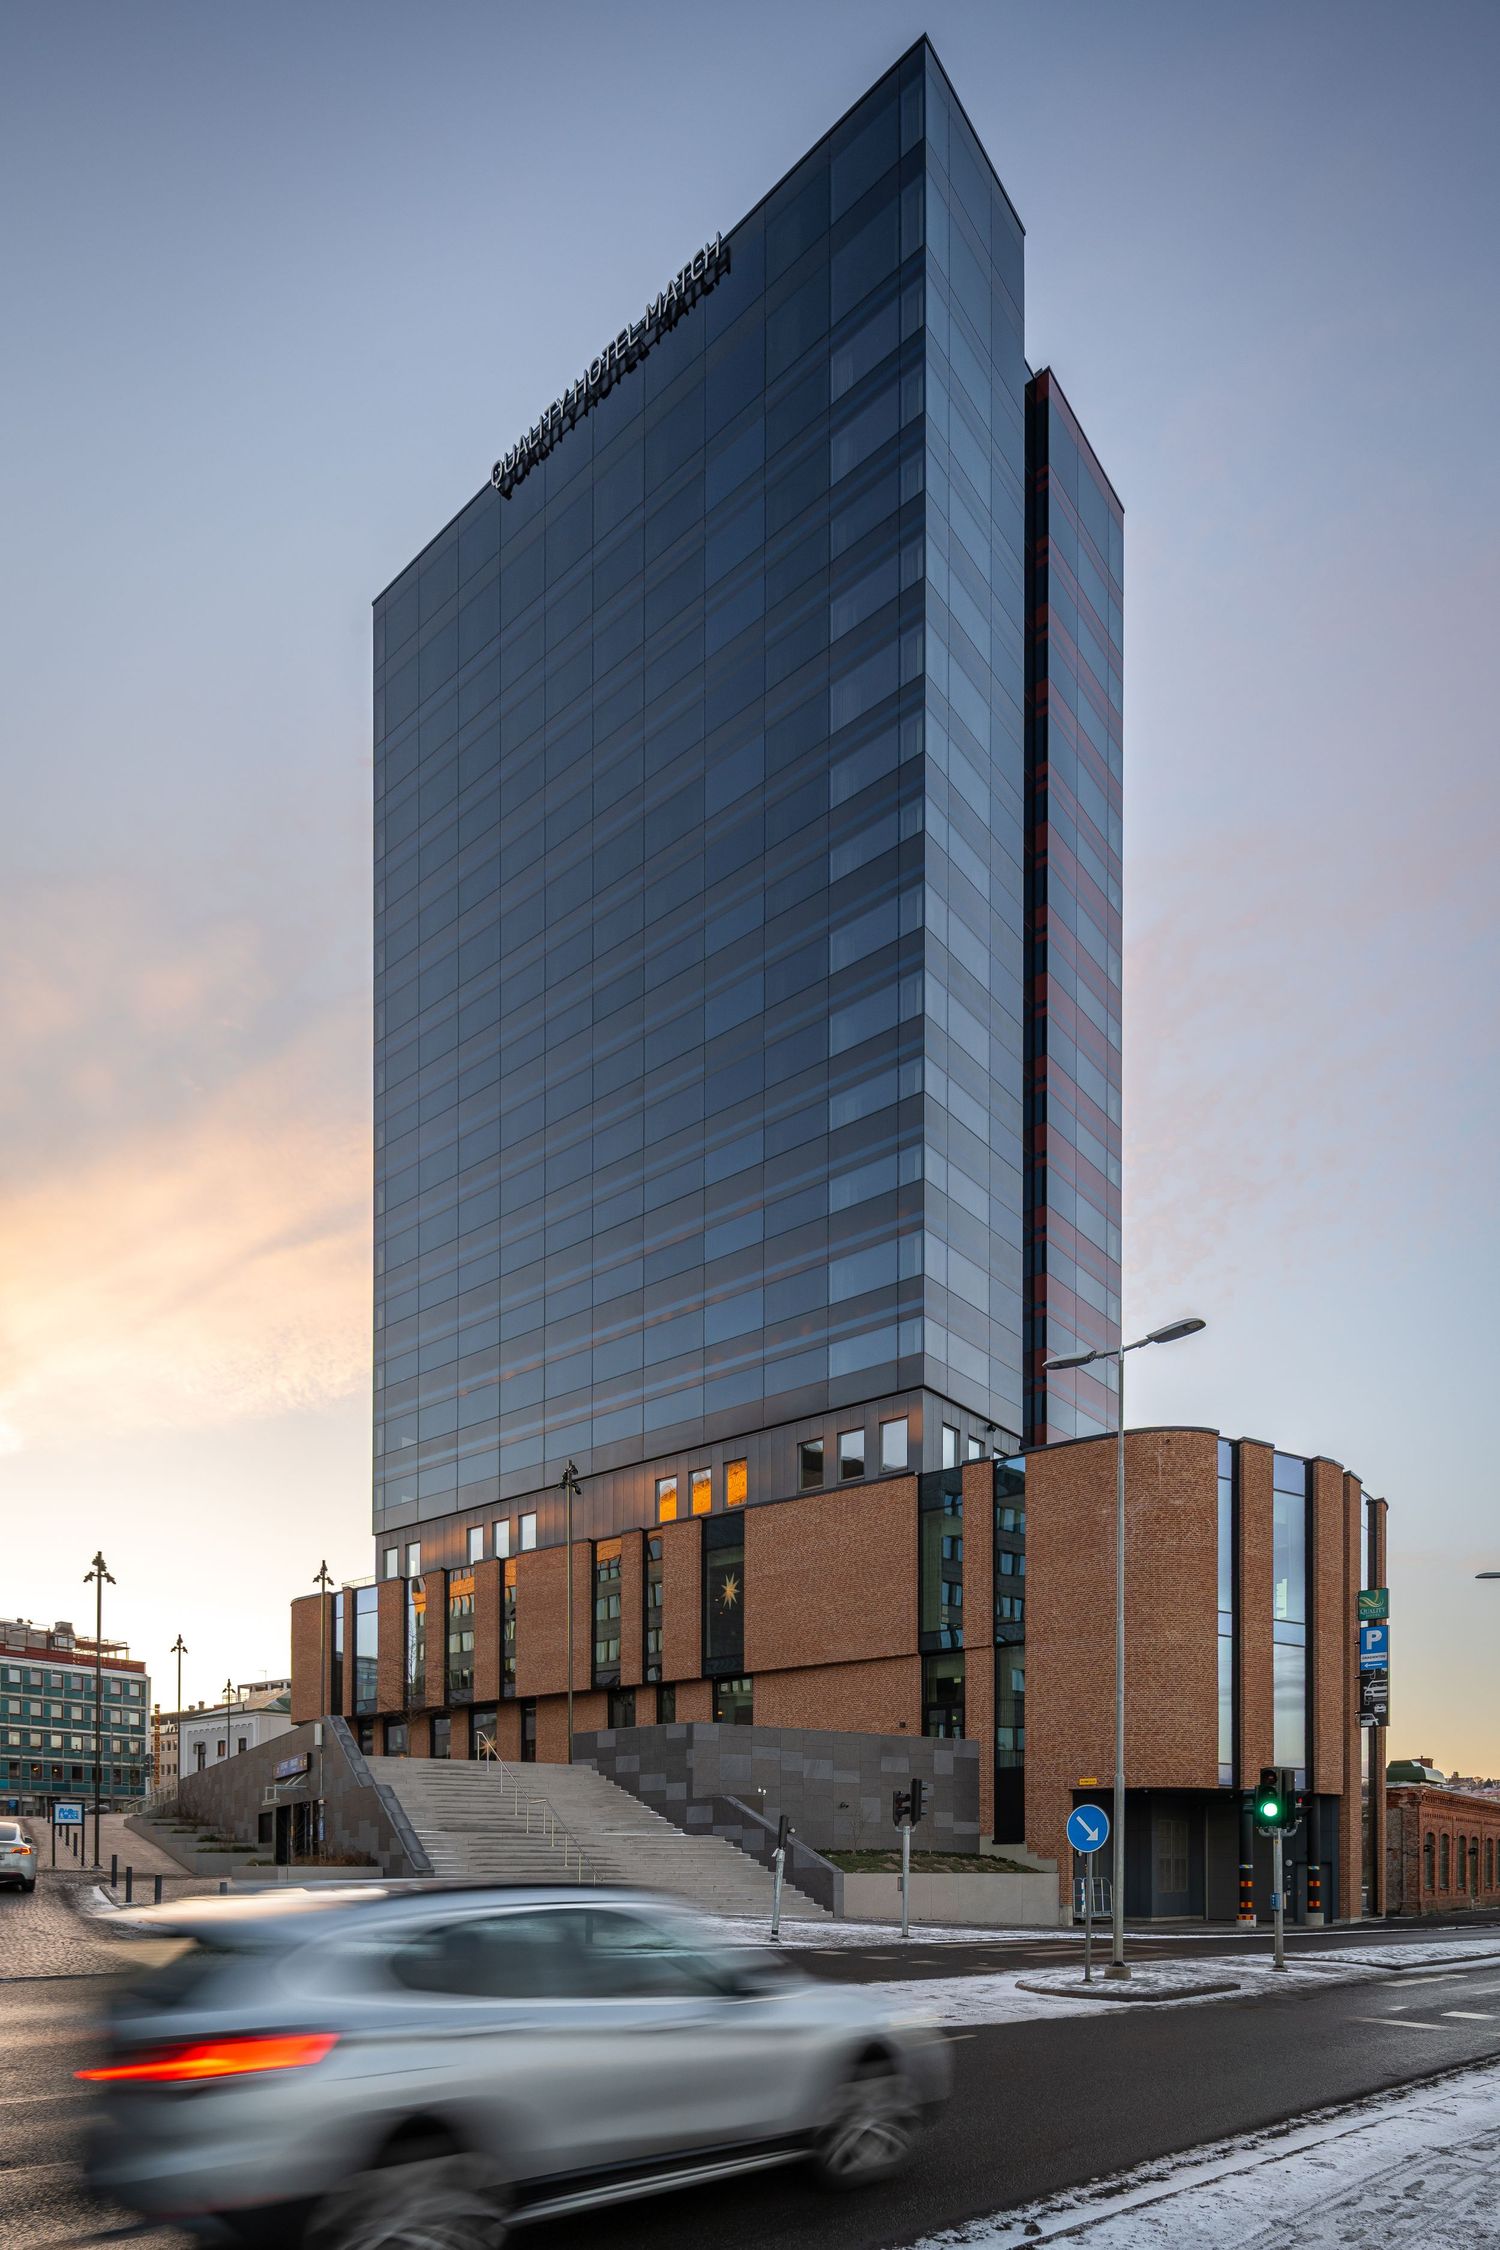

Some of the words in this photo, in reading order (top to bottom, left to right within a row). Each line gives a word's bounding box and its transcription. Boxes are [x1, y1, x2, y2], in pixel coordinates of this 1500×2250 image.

[491, 388, 570, 489] QUALITY
[574, 323, 640, 403] HOTEL
[646, 231, 723, 330] MATCH
[1360, 1607, 1385, 1615] QUALITY
[1366, 1630, 1382, 1650] P
